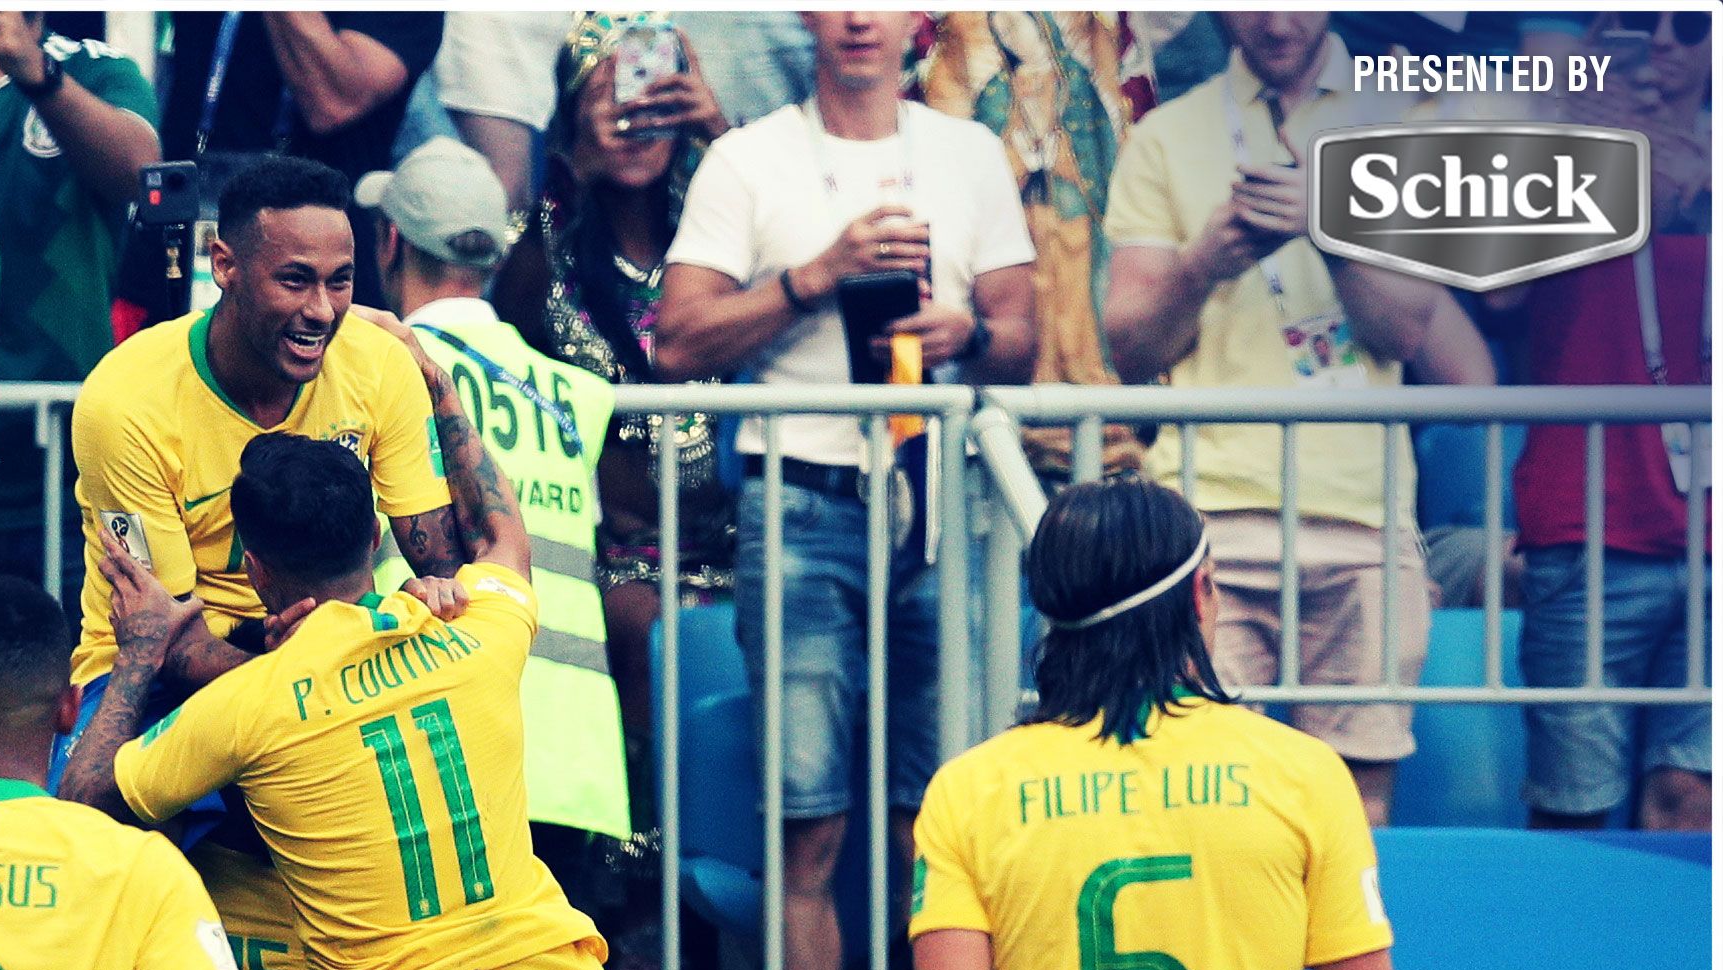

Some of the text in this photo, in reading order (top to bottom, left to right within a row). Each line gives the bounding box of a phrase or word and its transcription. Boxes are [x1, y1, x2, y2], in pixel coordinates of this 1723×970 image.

[359, 697, 495, 922] 11
[1019, 762, 1250, 825] FILIPE LUIS
